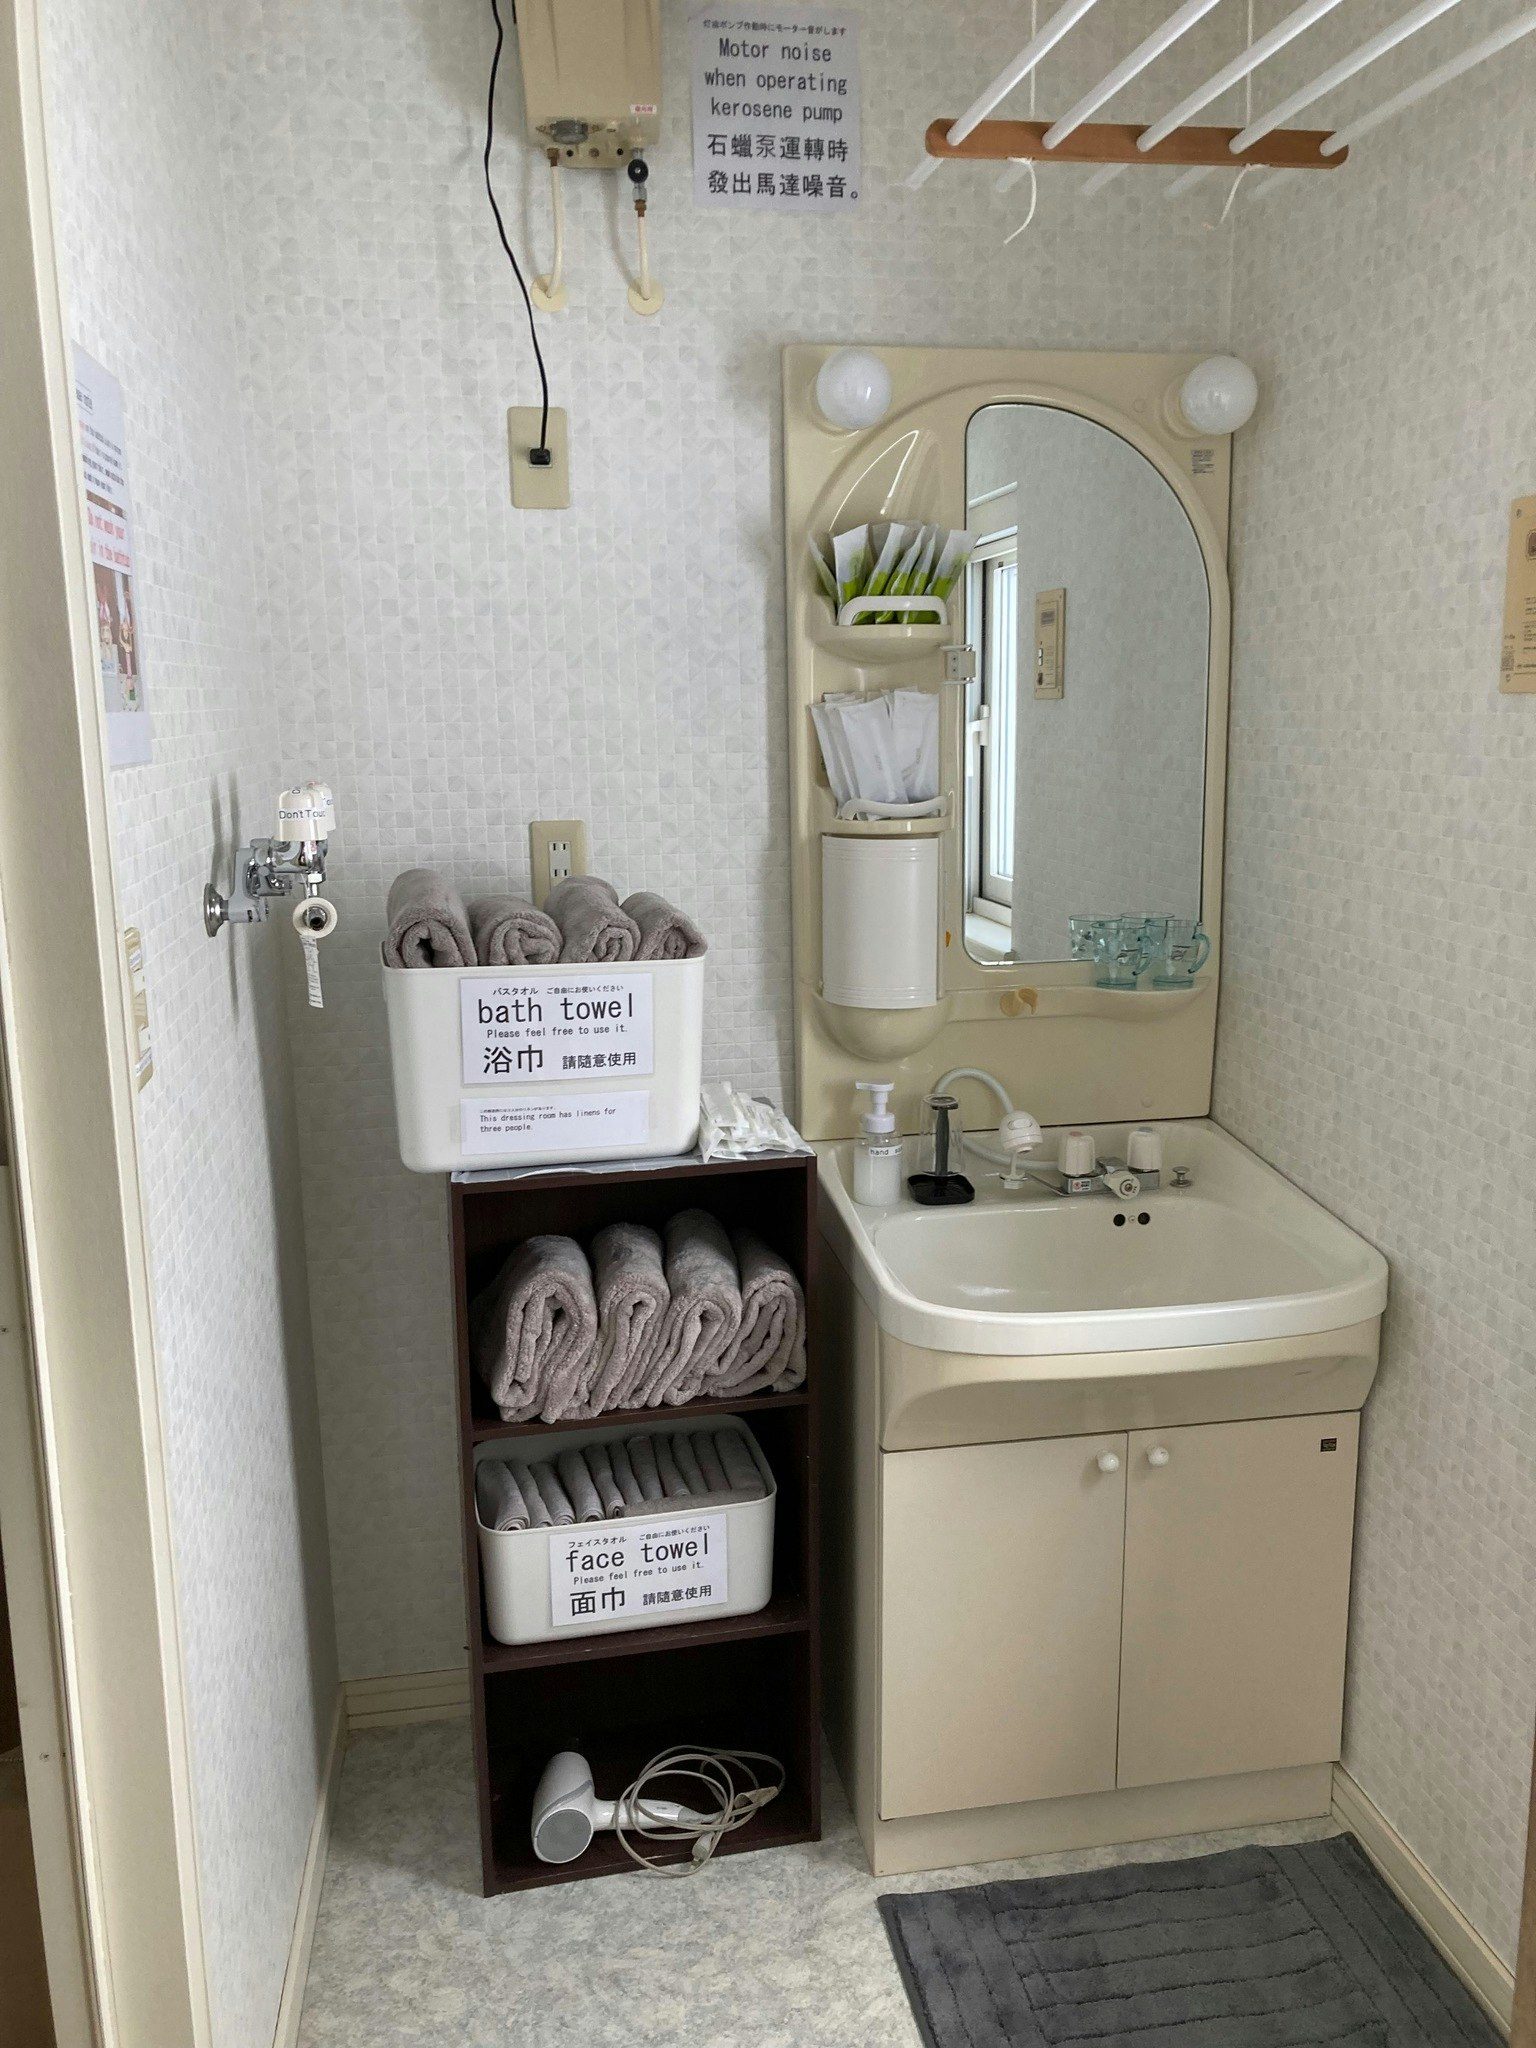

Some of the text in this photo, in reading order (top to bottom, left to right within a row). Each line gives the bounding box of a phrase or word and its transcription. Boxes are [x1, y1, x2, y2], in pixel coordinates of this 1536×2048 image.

[719, 37, 832, 62] Motor noise
[704, 67, 848, 96] when operating
[711, 96, 843, 124] kerosene pump
[707, 133, 849, 162] 石蠟泵運轉時
[707, 169, 858, 199] 發出馬達噪音。
[493, 985, 624, 996] バスタオル ご自由にお使いください
[478, 993, 633, 1024] bath towel
[487, 1023, 628, 1039] Please feel free to use it.
[483, 1044, 637, 1074] 浴巾 請隨意使用
[501, 1113, 535, 1121] dressing
[577, 1109, 601, 1117] linens
[604, 1107, 616, 1115] for
[480, 1125, 502, 1133] three
[566, 1532, 708, 1573] face towel
[568, 1536, 627, 1549] フェイスタオル
[573, 1574, 604, 1586] Please
[609, 1571, 628, 1581] feel
[633, 1568, 653, 1578] free
[658, 1566, 668, 1574] to
[671, 1564, 687, 1573] use
[570, 1585, 712, 1617] 面巾 請隨意使用
